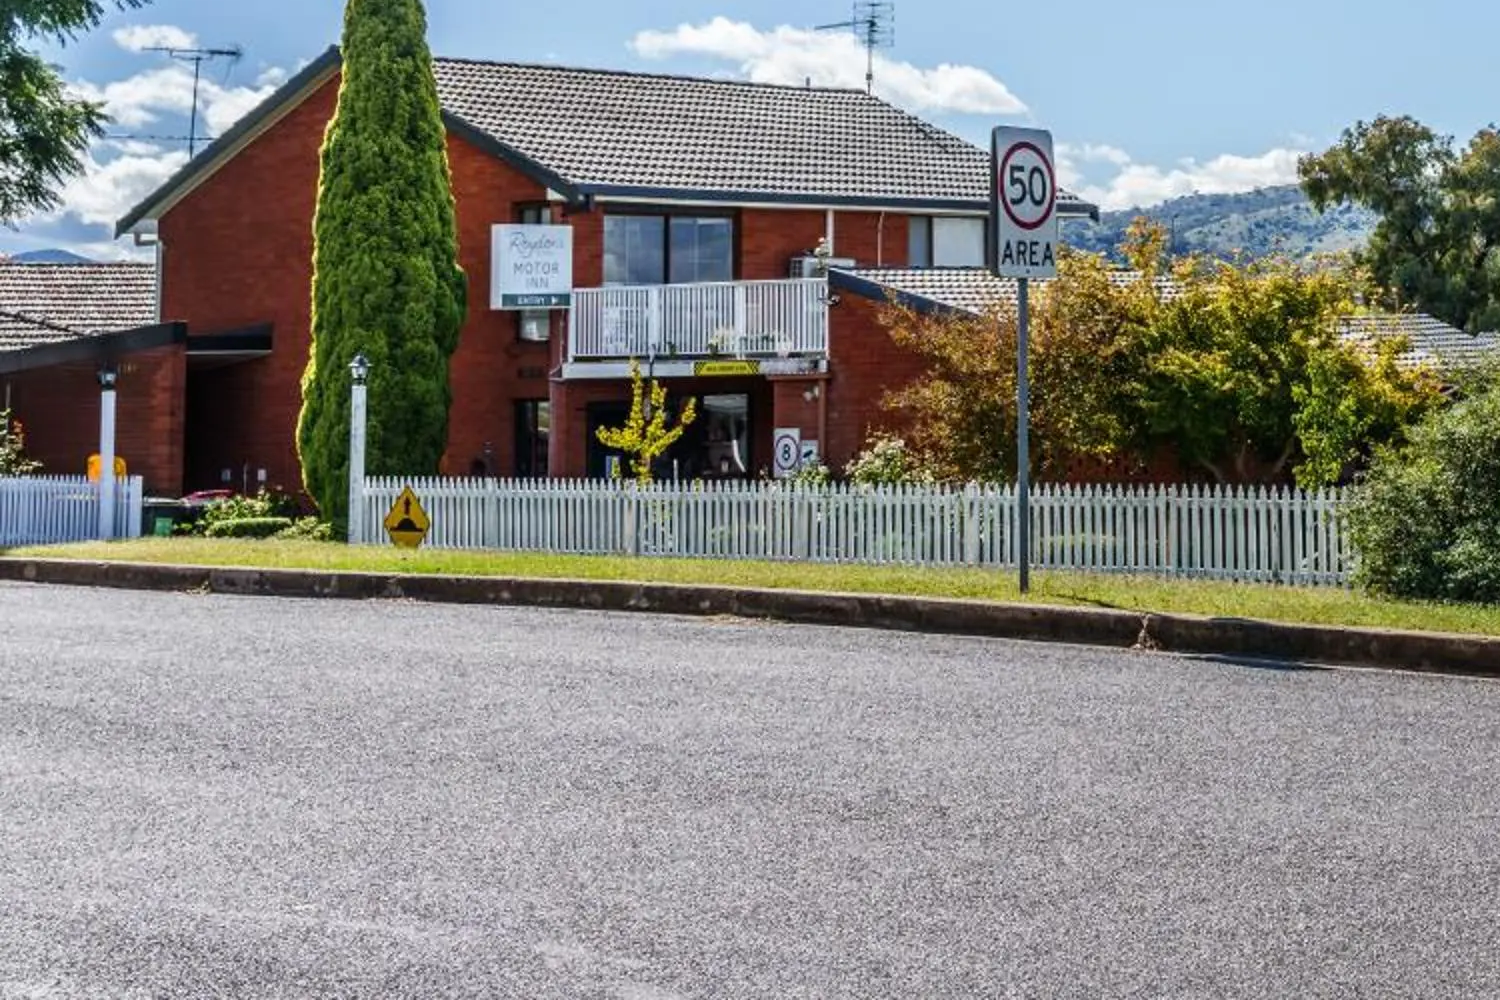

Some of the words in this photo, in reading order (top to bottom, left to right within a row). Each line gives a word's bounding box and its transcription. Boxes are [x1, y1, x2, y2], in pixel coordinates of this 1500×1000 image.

[1009, 164, 1047, 206] 50
[1001, 239, 1055, 267] AREA
[513, 262, 559, 275] MOTOR
[526, 277, 549, 288] INN
[782, 443, 791, 461] 8
